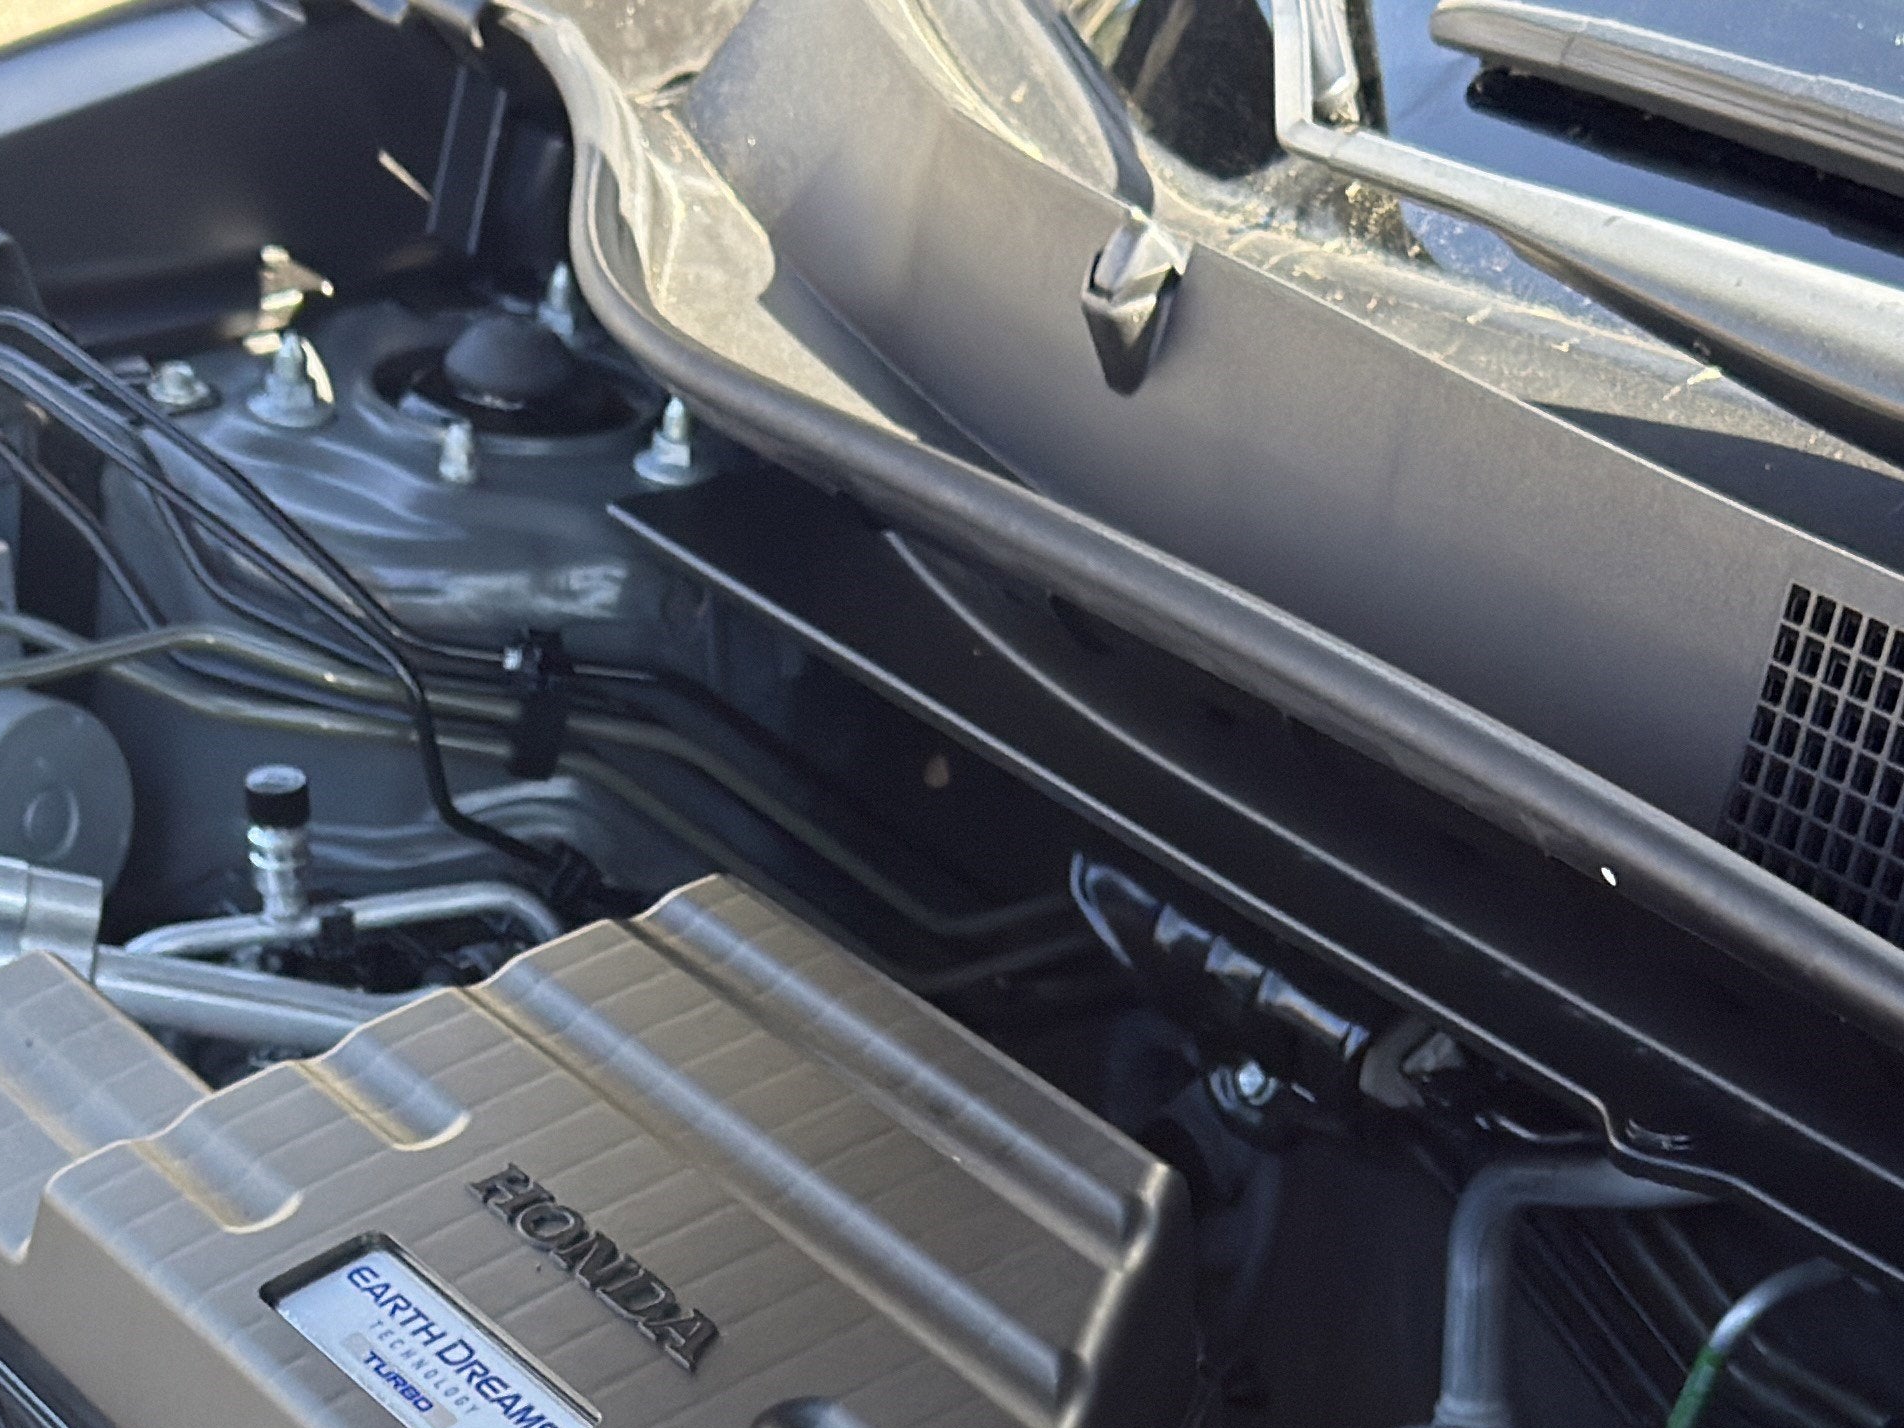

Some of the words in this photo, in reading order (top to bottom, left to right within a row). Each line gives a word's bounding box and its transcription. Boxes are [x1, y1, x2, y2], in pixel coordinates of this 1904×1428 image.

[346, 1265, 447, 1353] EARTH
[464, 1162, 722, 1374] HONDA
[362, 1350, 435, 1414] TURBO
[368, 1318, 481, 1416] TECHNOLOGY
